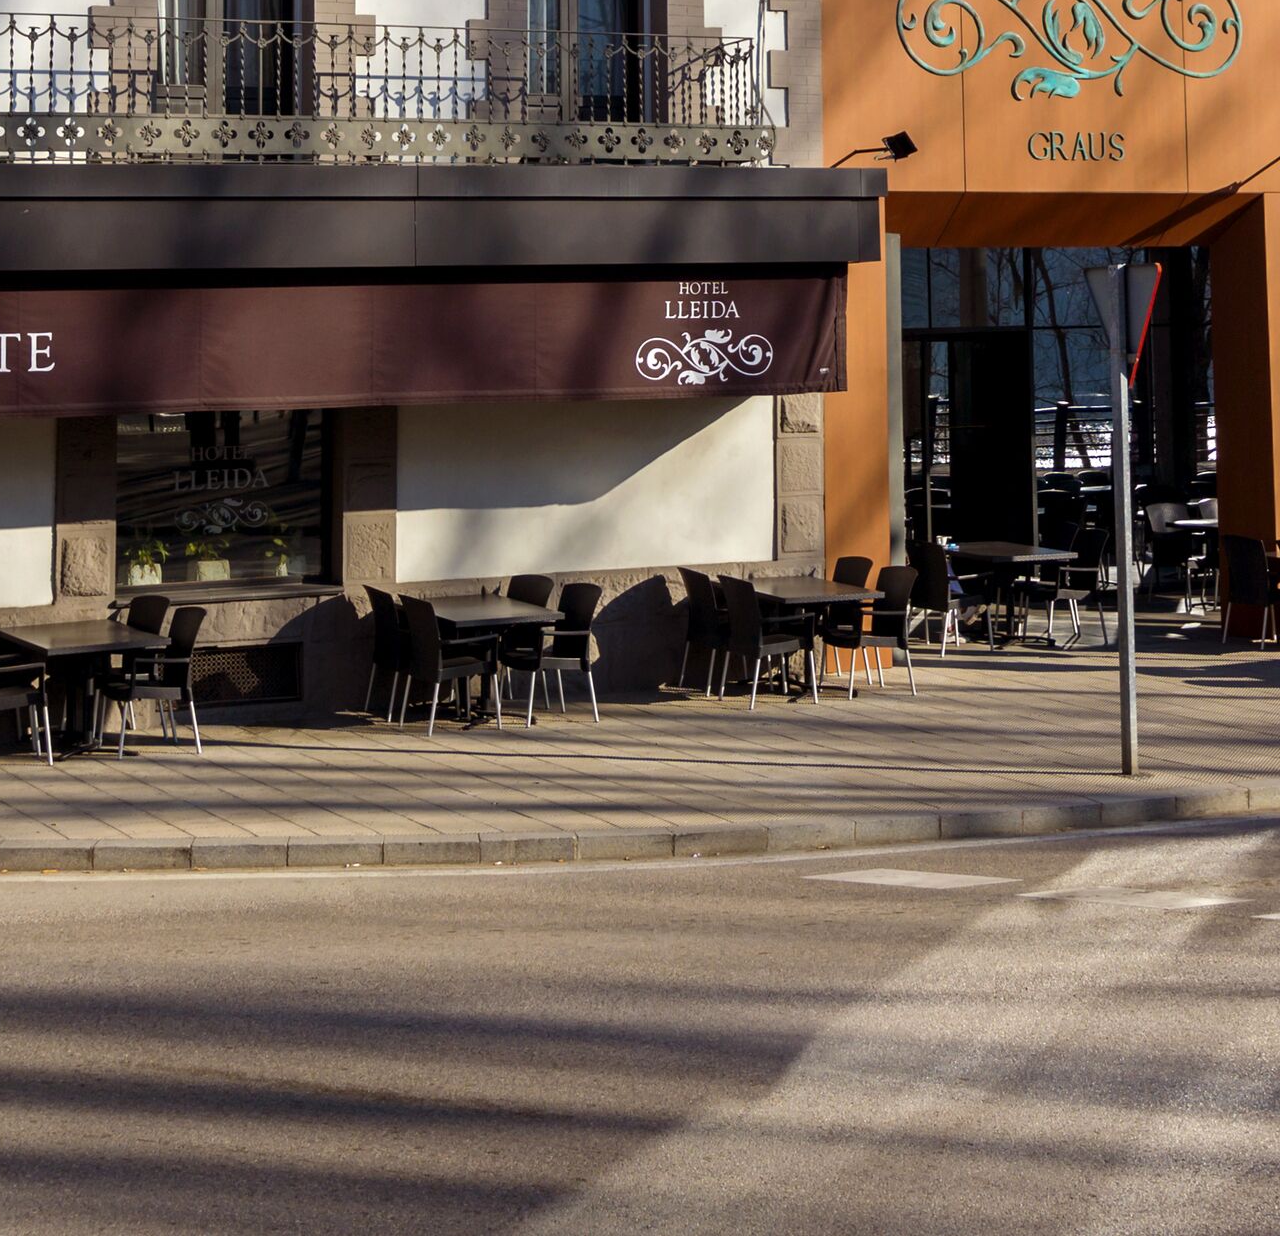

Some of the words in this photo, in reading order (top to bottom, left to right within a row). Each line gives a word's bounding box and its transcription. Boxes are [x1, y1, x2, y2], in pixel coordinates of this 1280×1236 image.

[1027, 131, 1125, 162] GRAUS
[679, 282, 728, 295] HOTEL
[665, 300, 740, 319] LLEIDA
[192, 446, 252, 462] HOTEL
[174, 468, 270, 492] LLEIDA
